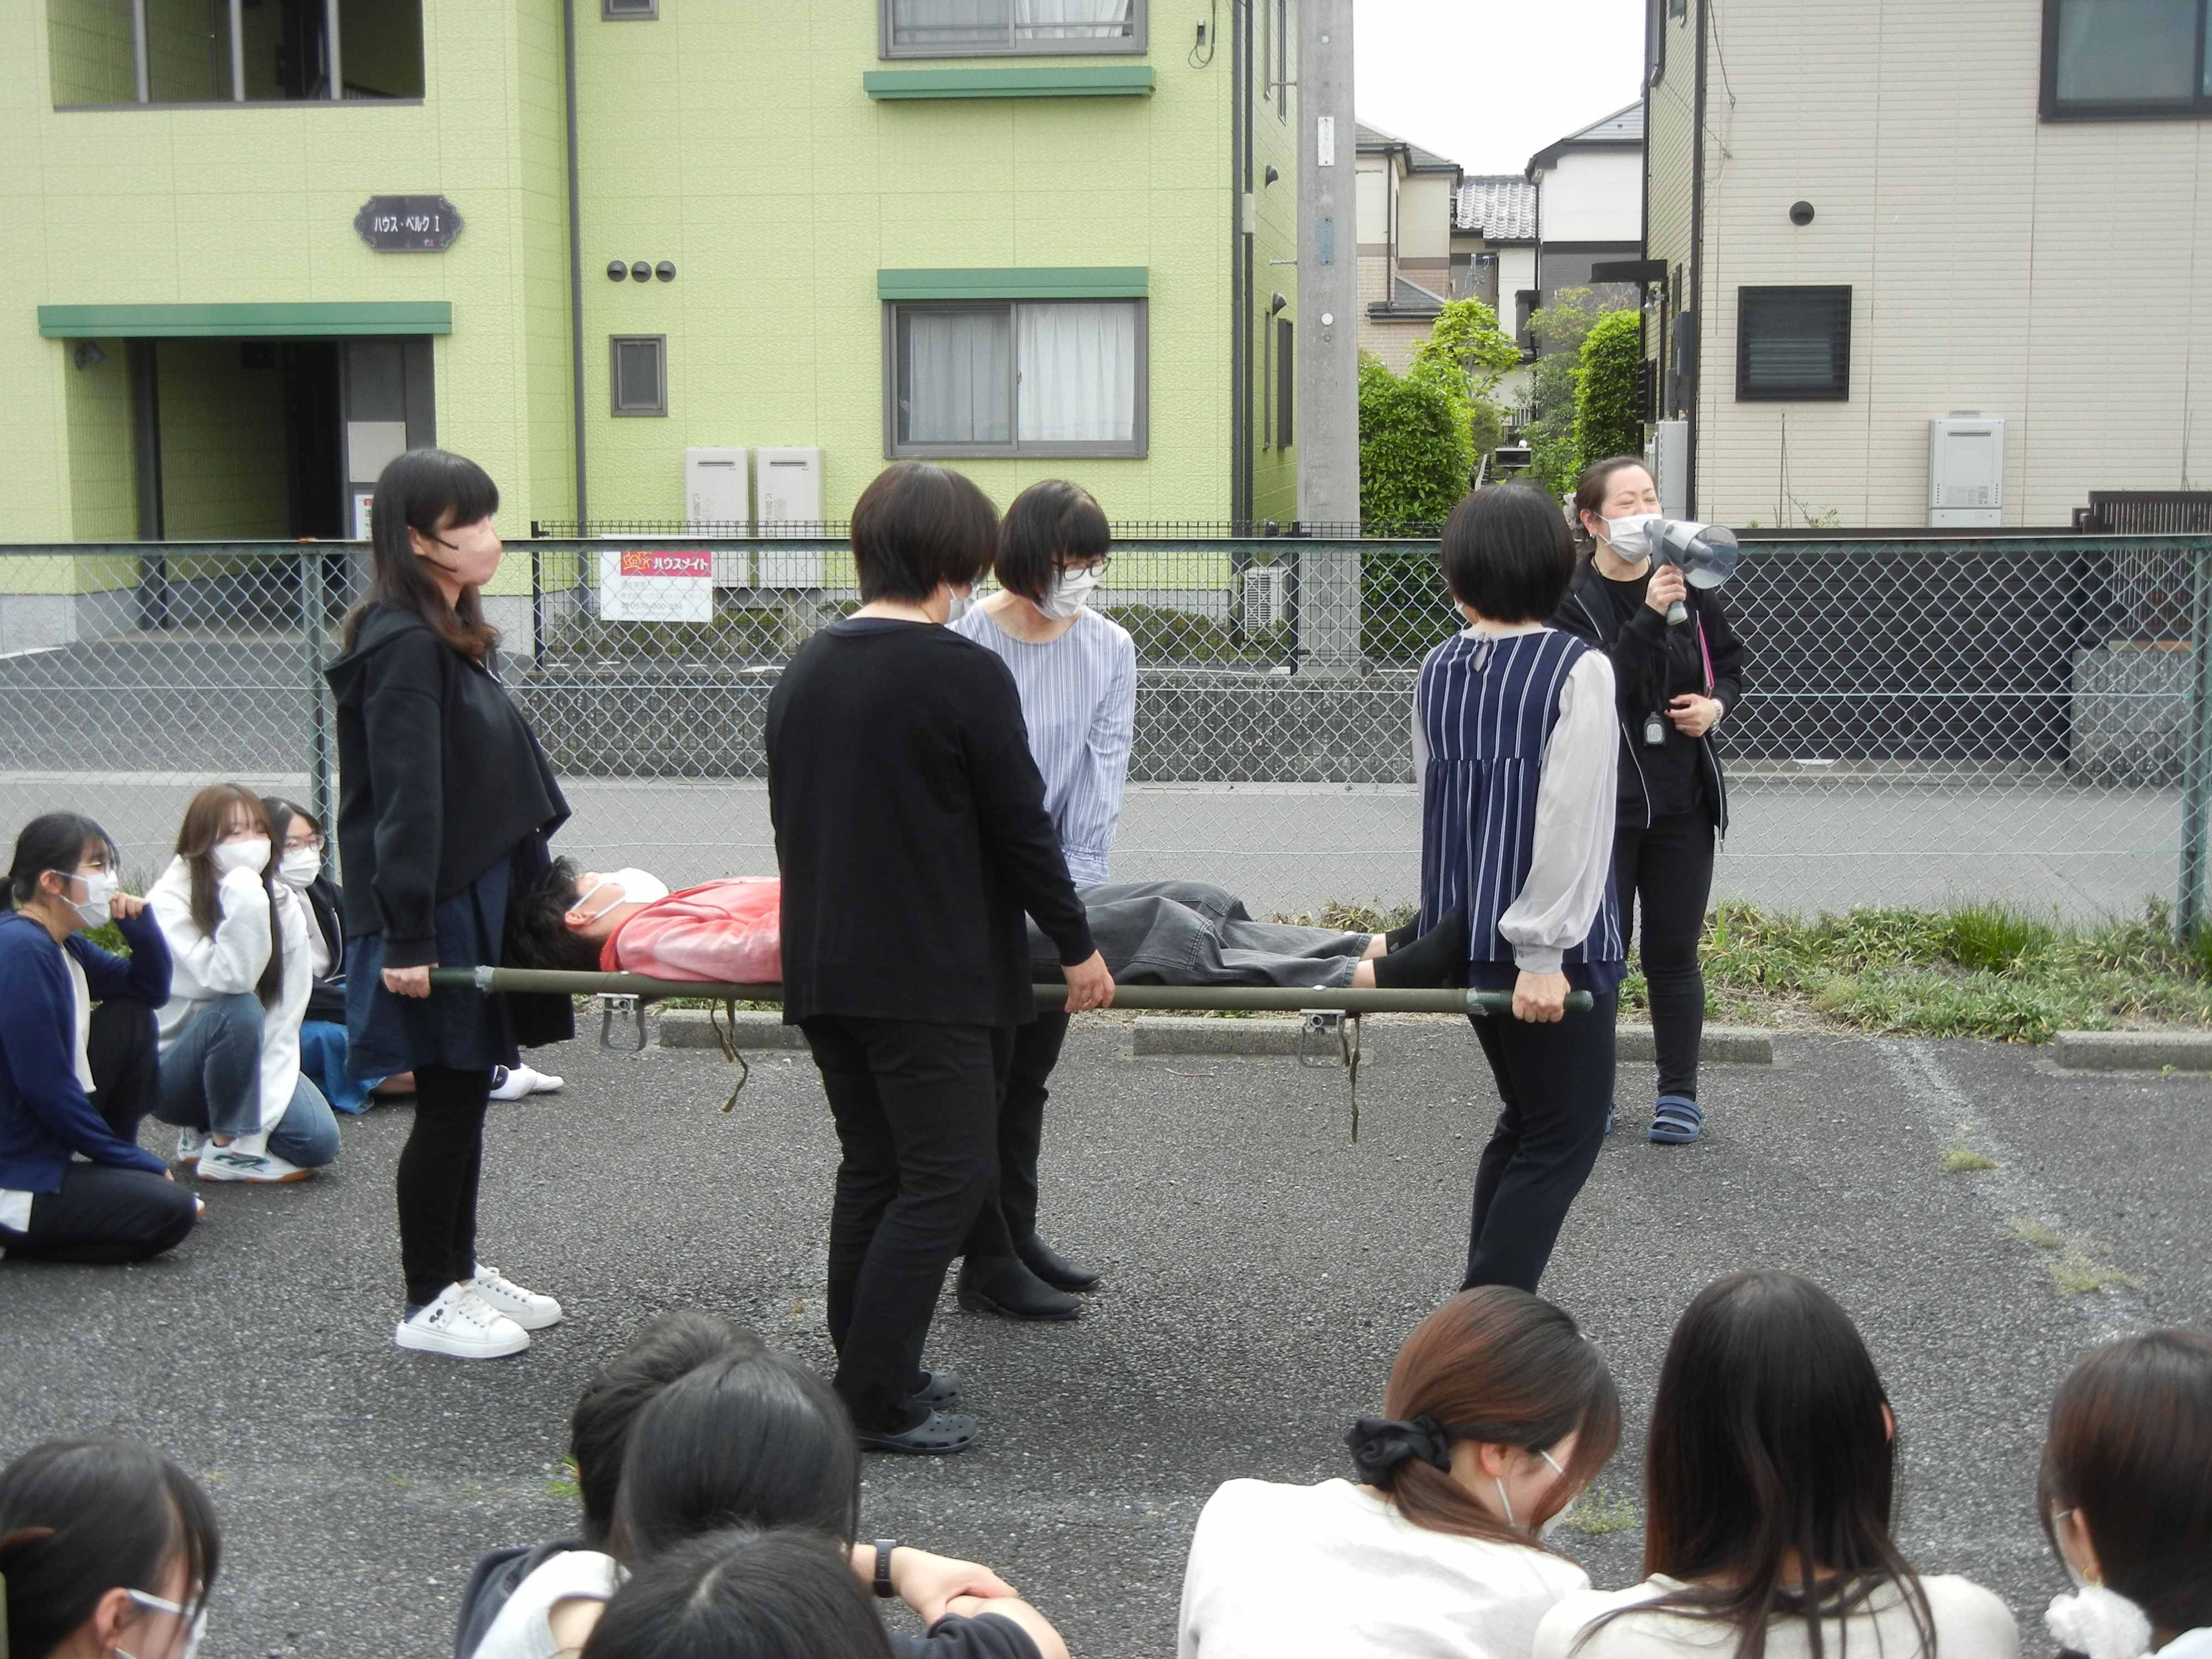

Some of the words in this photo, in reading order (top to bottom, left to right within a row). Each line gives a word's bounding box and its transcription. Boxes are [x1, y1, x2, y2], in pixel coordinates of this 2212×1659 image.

[374, 216, 430, 232] ハウス・ベルク
[654, 557, 709, 570] ハウスメイト
